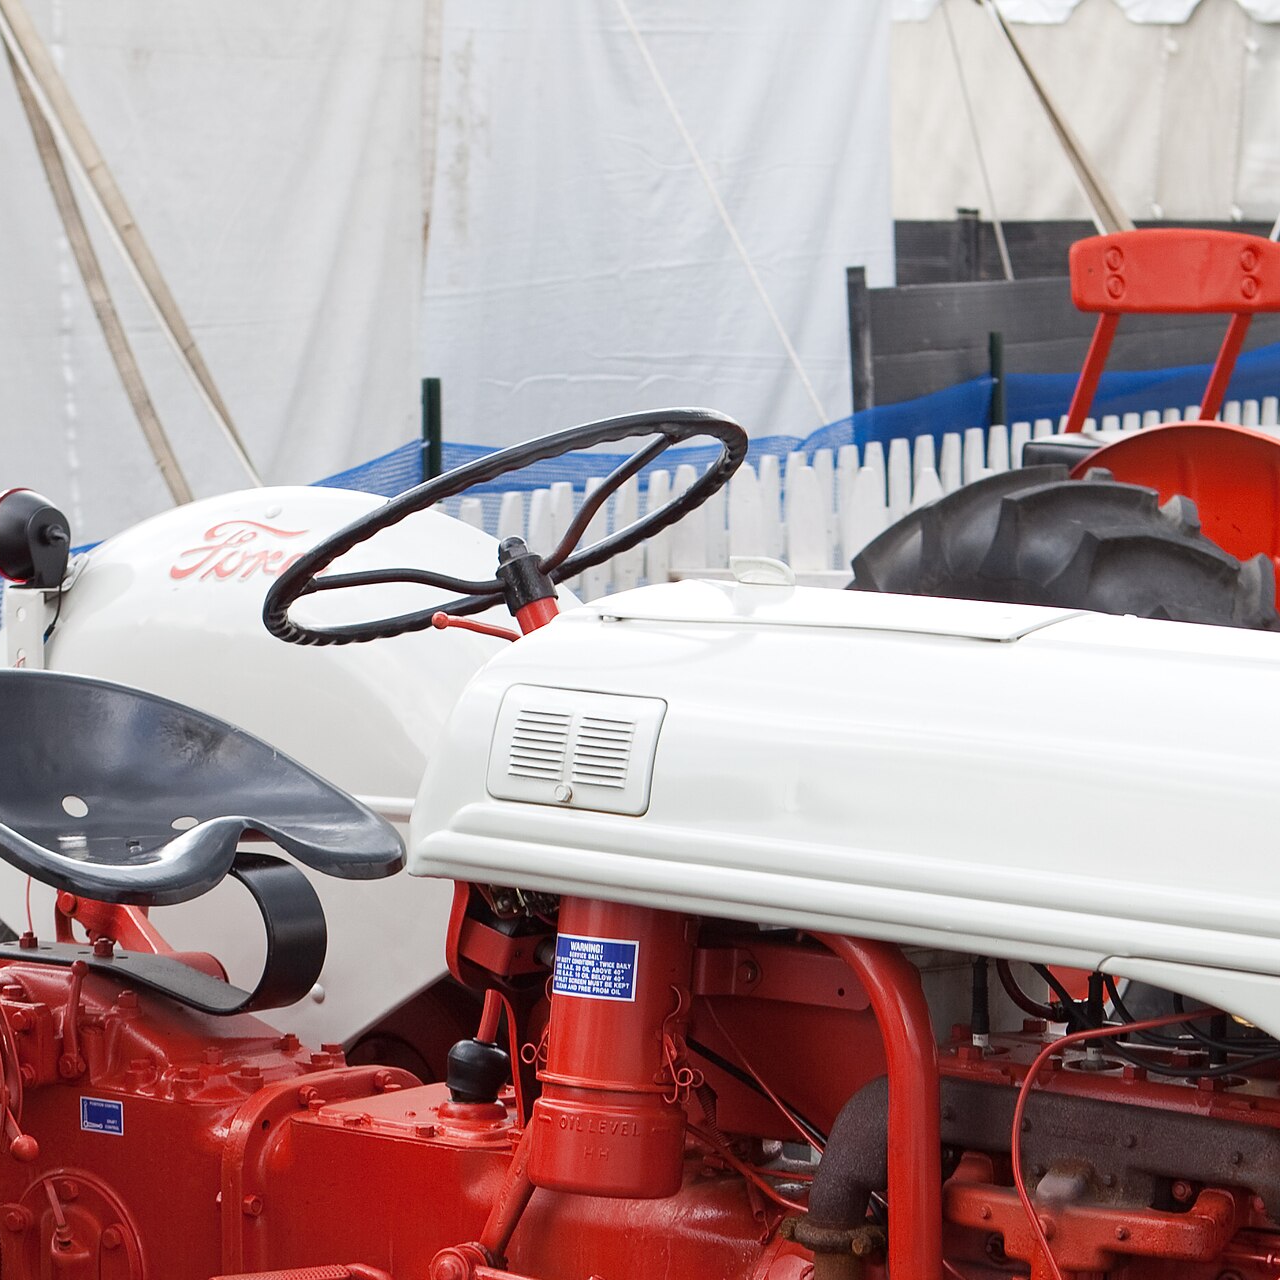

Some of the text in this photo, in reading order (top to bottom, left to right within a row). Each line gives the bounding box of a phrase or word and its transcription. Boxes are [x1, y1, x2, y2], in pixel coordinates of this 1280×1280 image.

[570, 941, 604, 954] WARNING!
[599, 961, 615, 969] TWICE
[616, 962, 631, 970] DAILY
[592, 967, 612, 975] ABOVE
[591, 973, 612, 981] BELOW
[588, 979, 603, 987] MUST
[604, 981, 613, 989] BE
[614, 982, 630, 990] KEPT
[592, 986, 610, 994] FROM
[558, 1114, 641, 1137] OIL LEVEL
